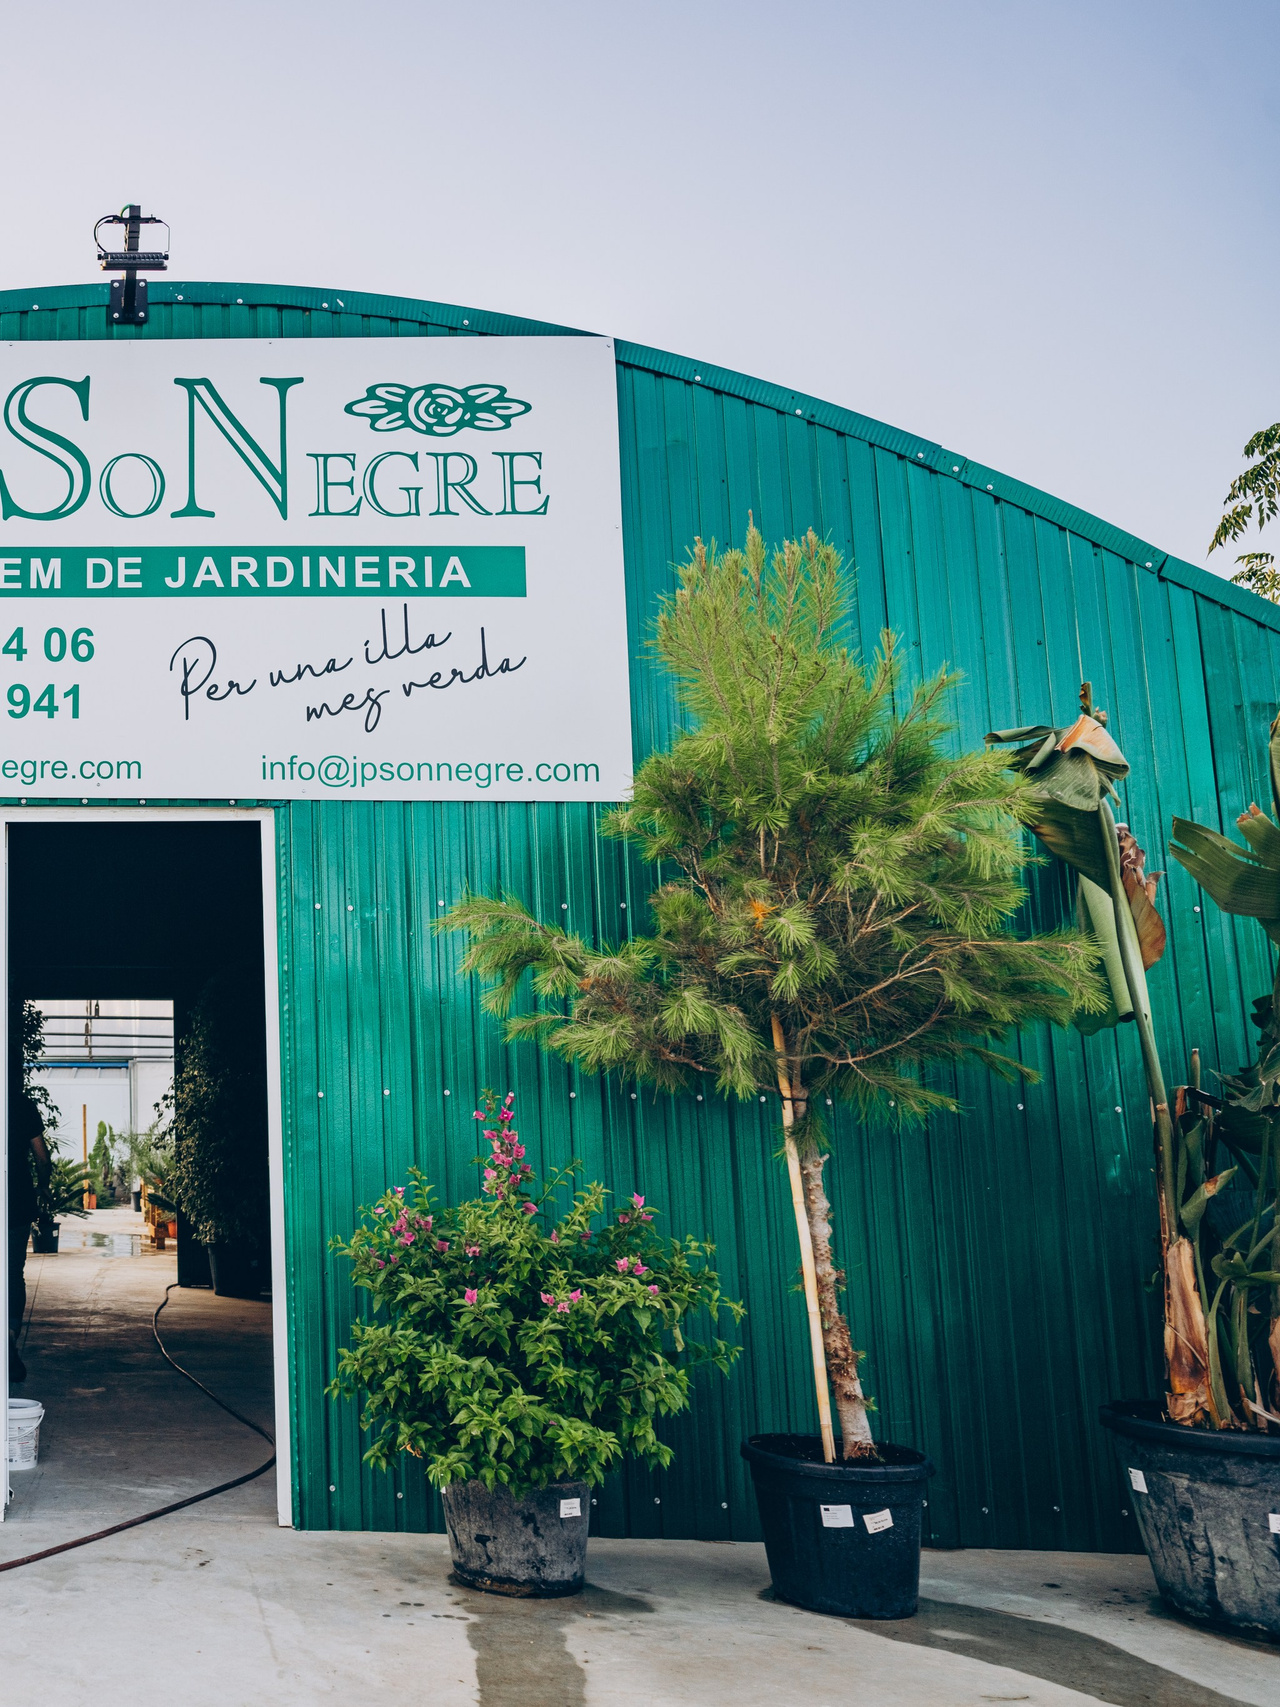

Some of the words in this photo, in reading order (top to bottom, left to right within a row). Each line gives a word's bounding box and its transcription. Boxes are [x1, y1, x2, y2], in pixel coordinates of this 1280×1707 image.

[86, 556, 143, 589] DE
[164, 556, 472, 588] JARDINERIA
[43, 626, 95, 663] 06
[169, 635, 258, 721] Per
[269, 657, 354, 688] una
[363, 602, 453, 665] illa
[401, 626, 528, 698] verda
[6, 683, 80, 720] 941
[261, 754, 600, 789] info@jpsonnegre.com
